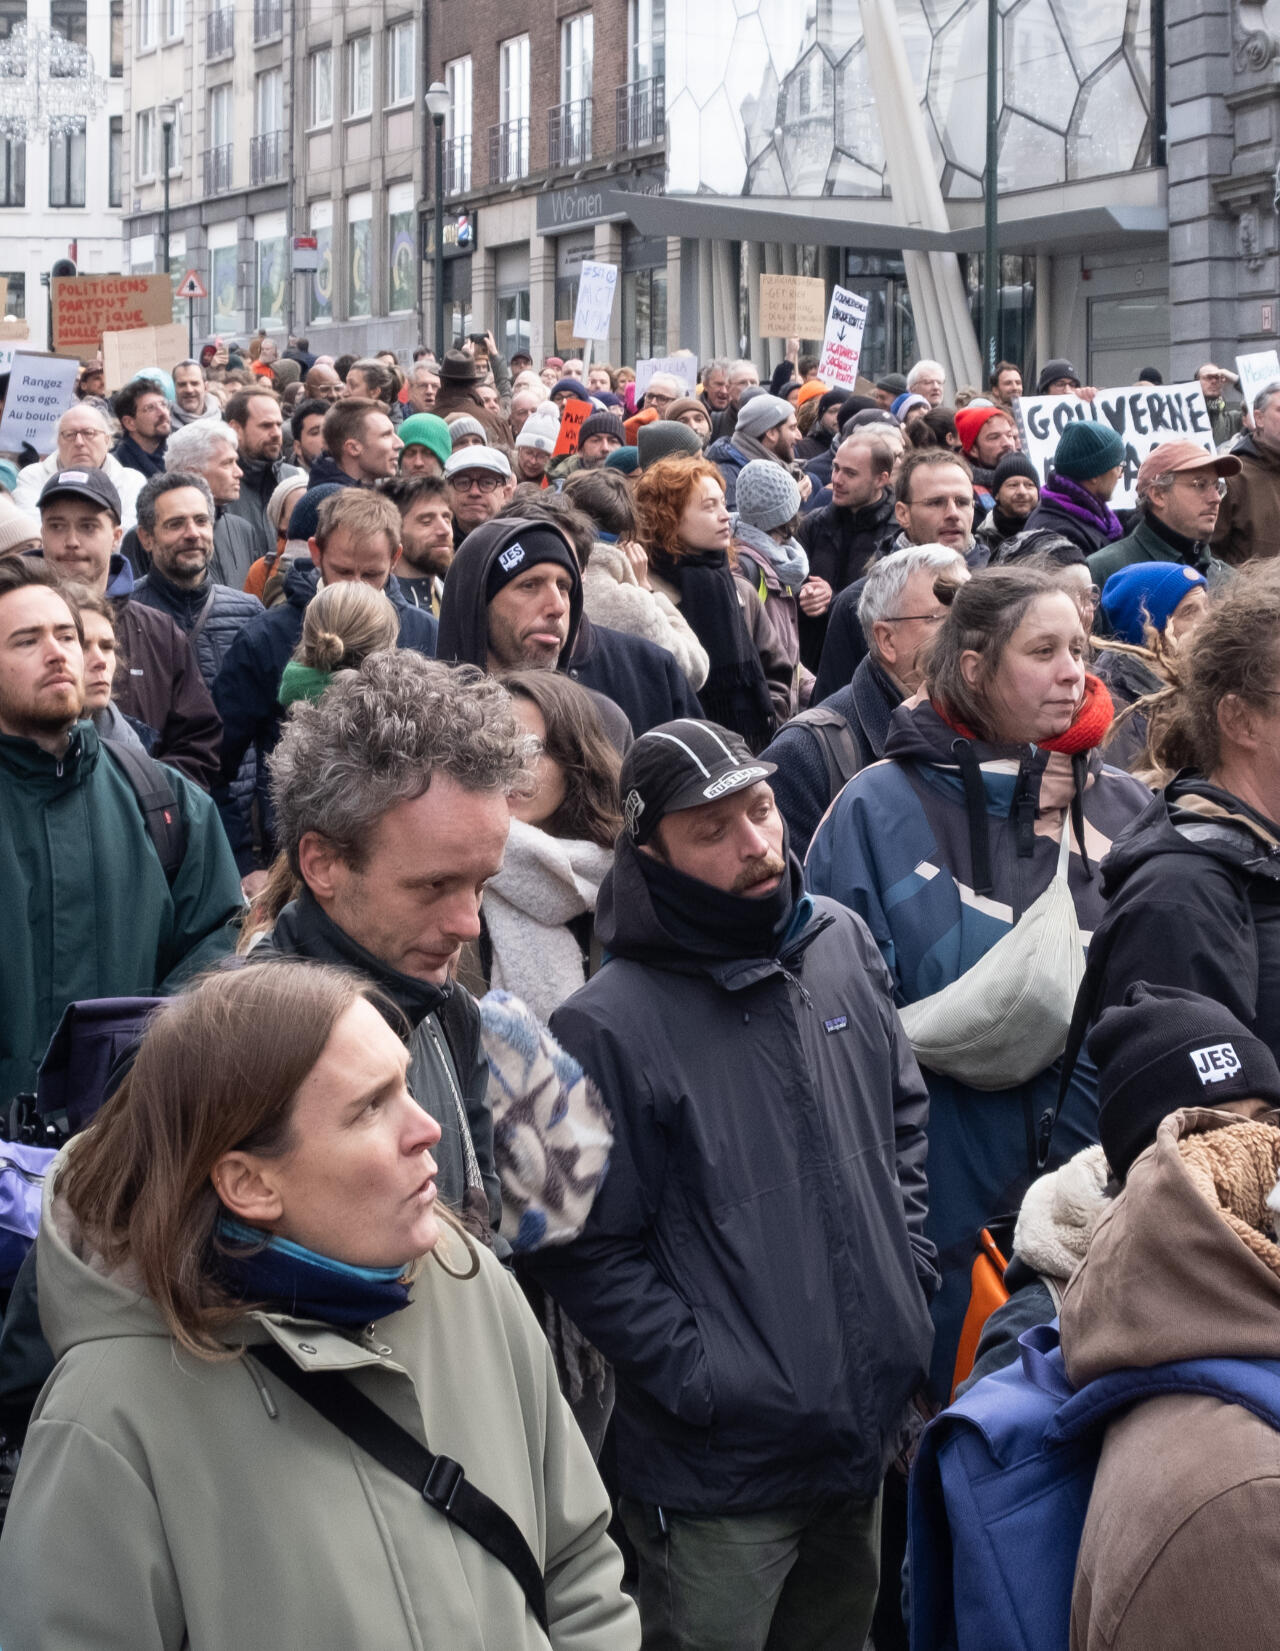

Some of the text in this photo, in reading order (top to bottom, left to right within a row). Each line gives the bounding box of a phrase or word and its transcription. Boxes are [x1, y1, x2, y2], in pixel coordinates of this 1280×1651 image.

[57, 297, 128, 313] PARTOUT
[22, 376, 62, 389] Rangez
[16, 394, 60, 406] vos ego.
[8, 410, 23, 420] Au
[25, 427, 36, 438] !!!
[503, 546, 522, 565] JES
[1199, 1048, 1237, 1073] JES
